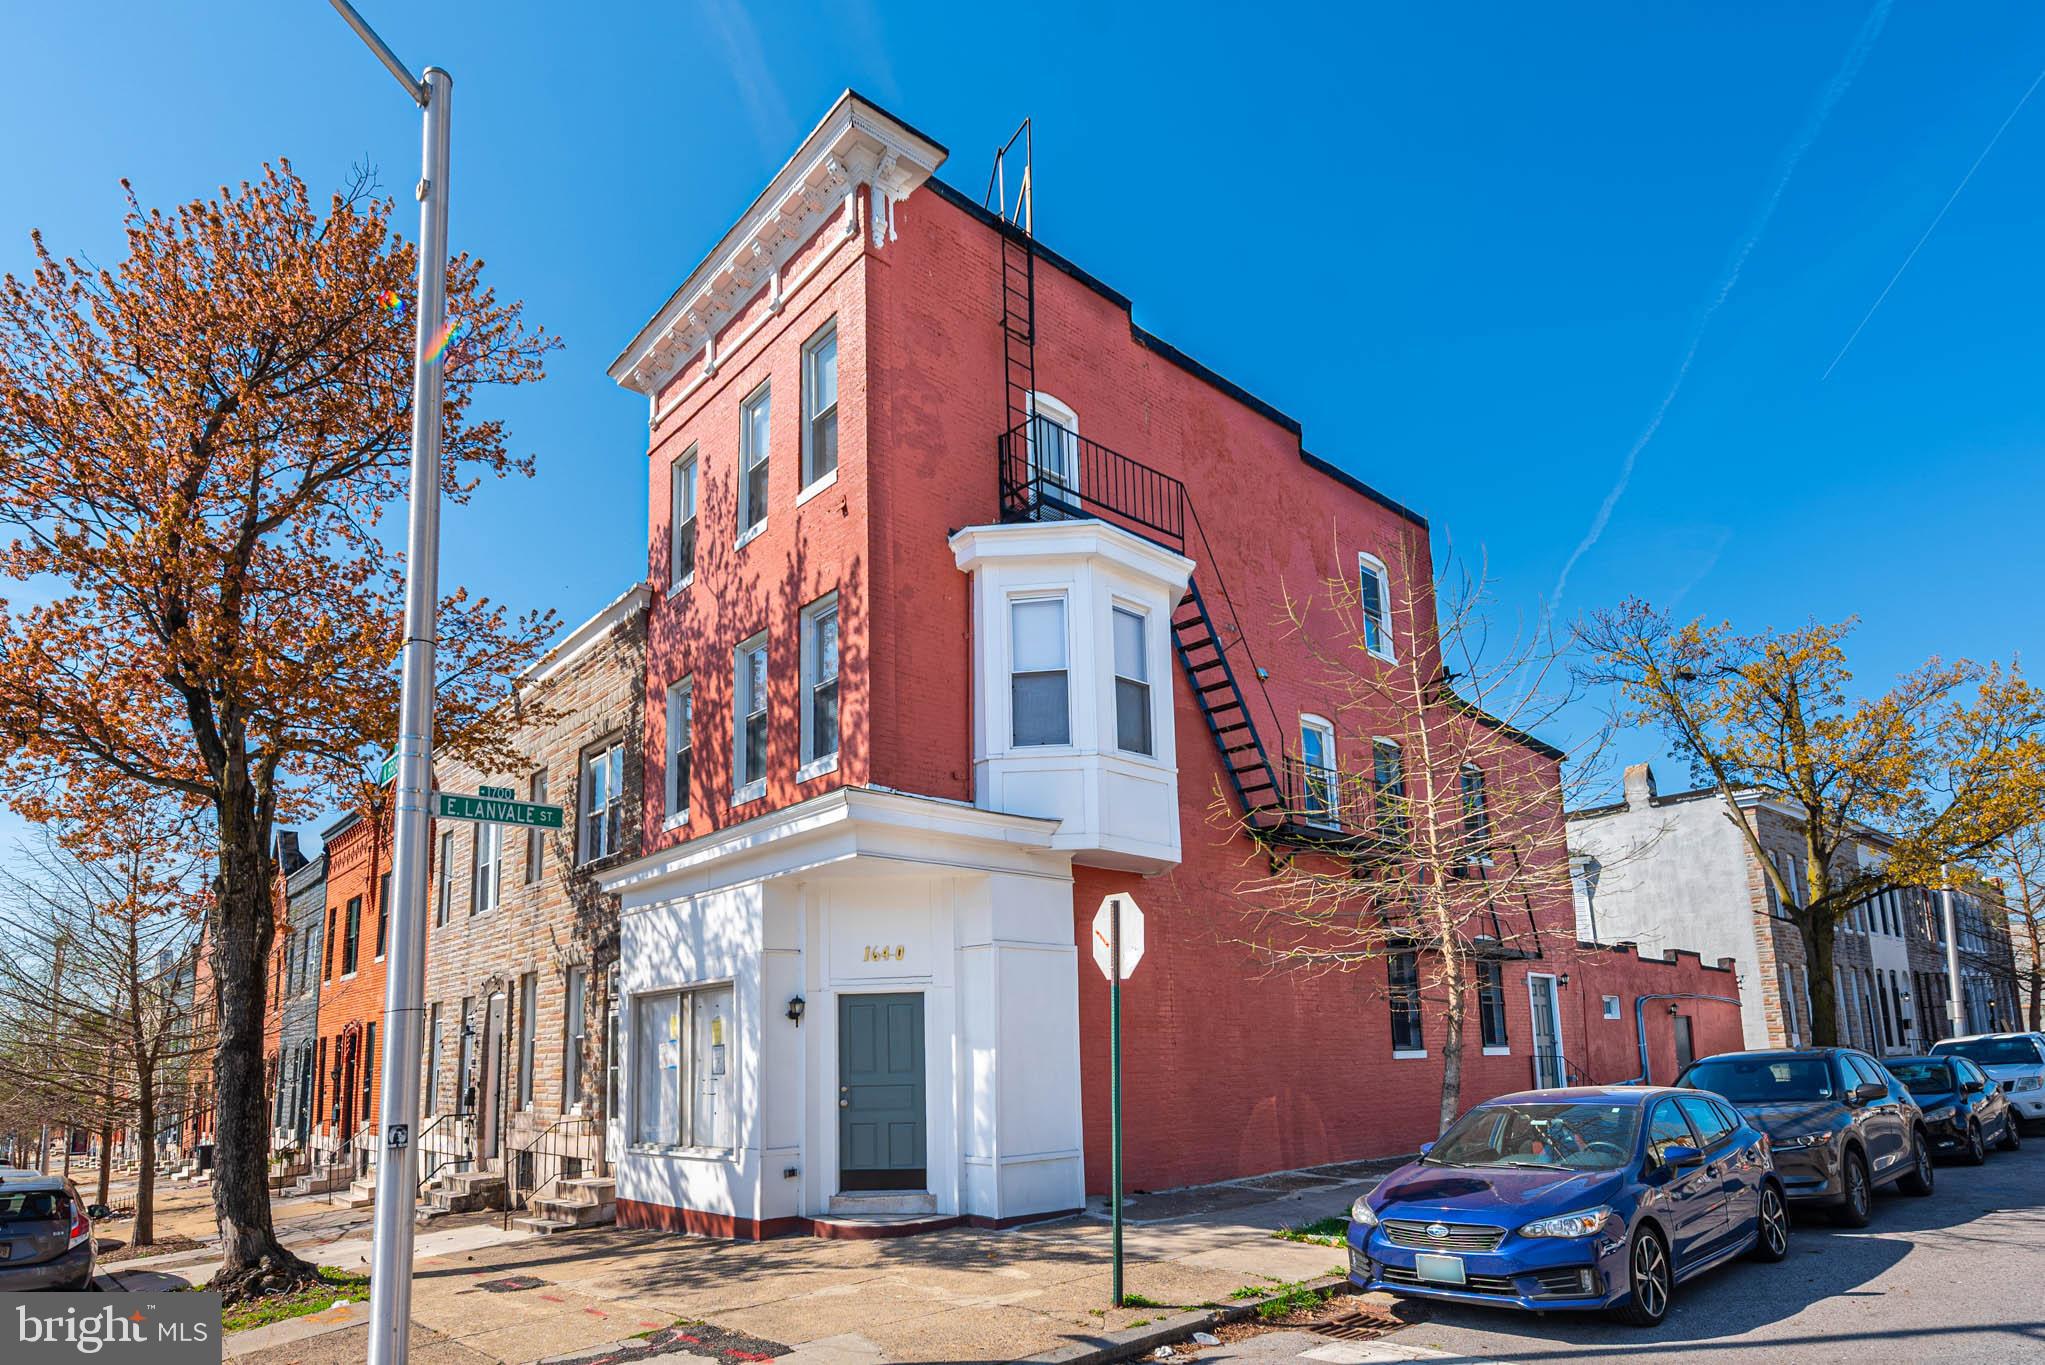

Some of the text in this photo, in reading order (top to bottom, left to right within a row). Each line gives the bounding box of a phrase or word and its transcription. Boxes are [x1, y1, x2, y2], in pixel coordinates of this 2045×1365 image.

[487, 787, 512, 799] 1700
[447, 798, 460, 816] E.
[465, 800, 534, 823] LANVALE
[863, 945, 904, 961] 1640
